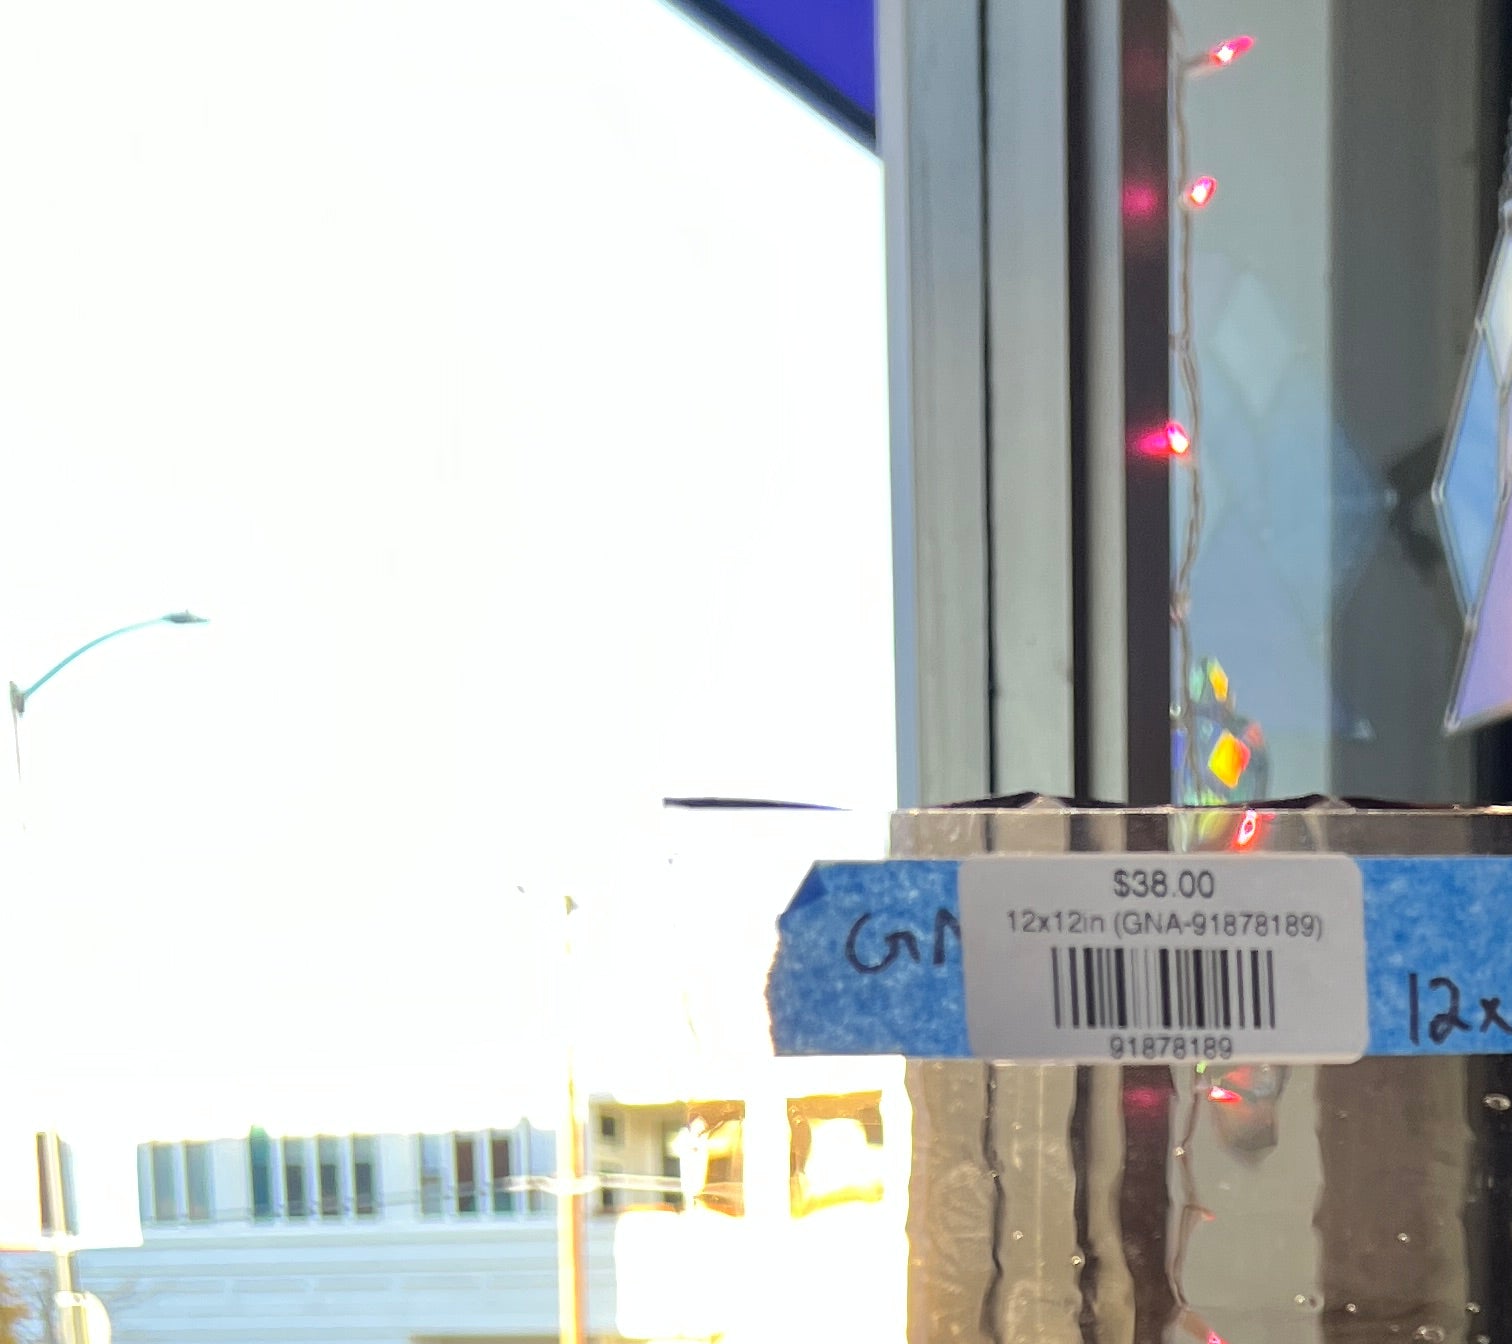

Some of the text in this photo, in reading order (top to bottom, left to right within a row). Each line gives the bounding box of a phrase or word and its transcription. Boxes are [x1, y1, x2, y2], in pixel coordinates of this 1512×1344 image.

[1113, 869, 1215, 899] $38.00
[1006, 910, 1324, 941] 12x12in (GNA-91878189)
[844, 907, 962, 975] GN
[1109, 1036, 1233, 1060] 91878189
